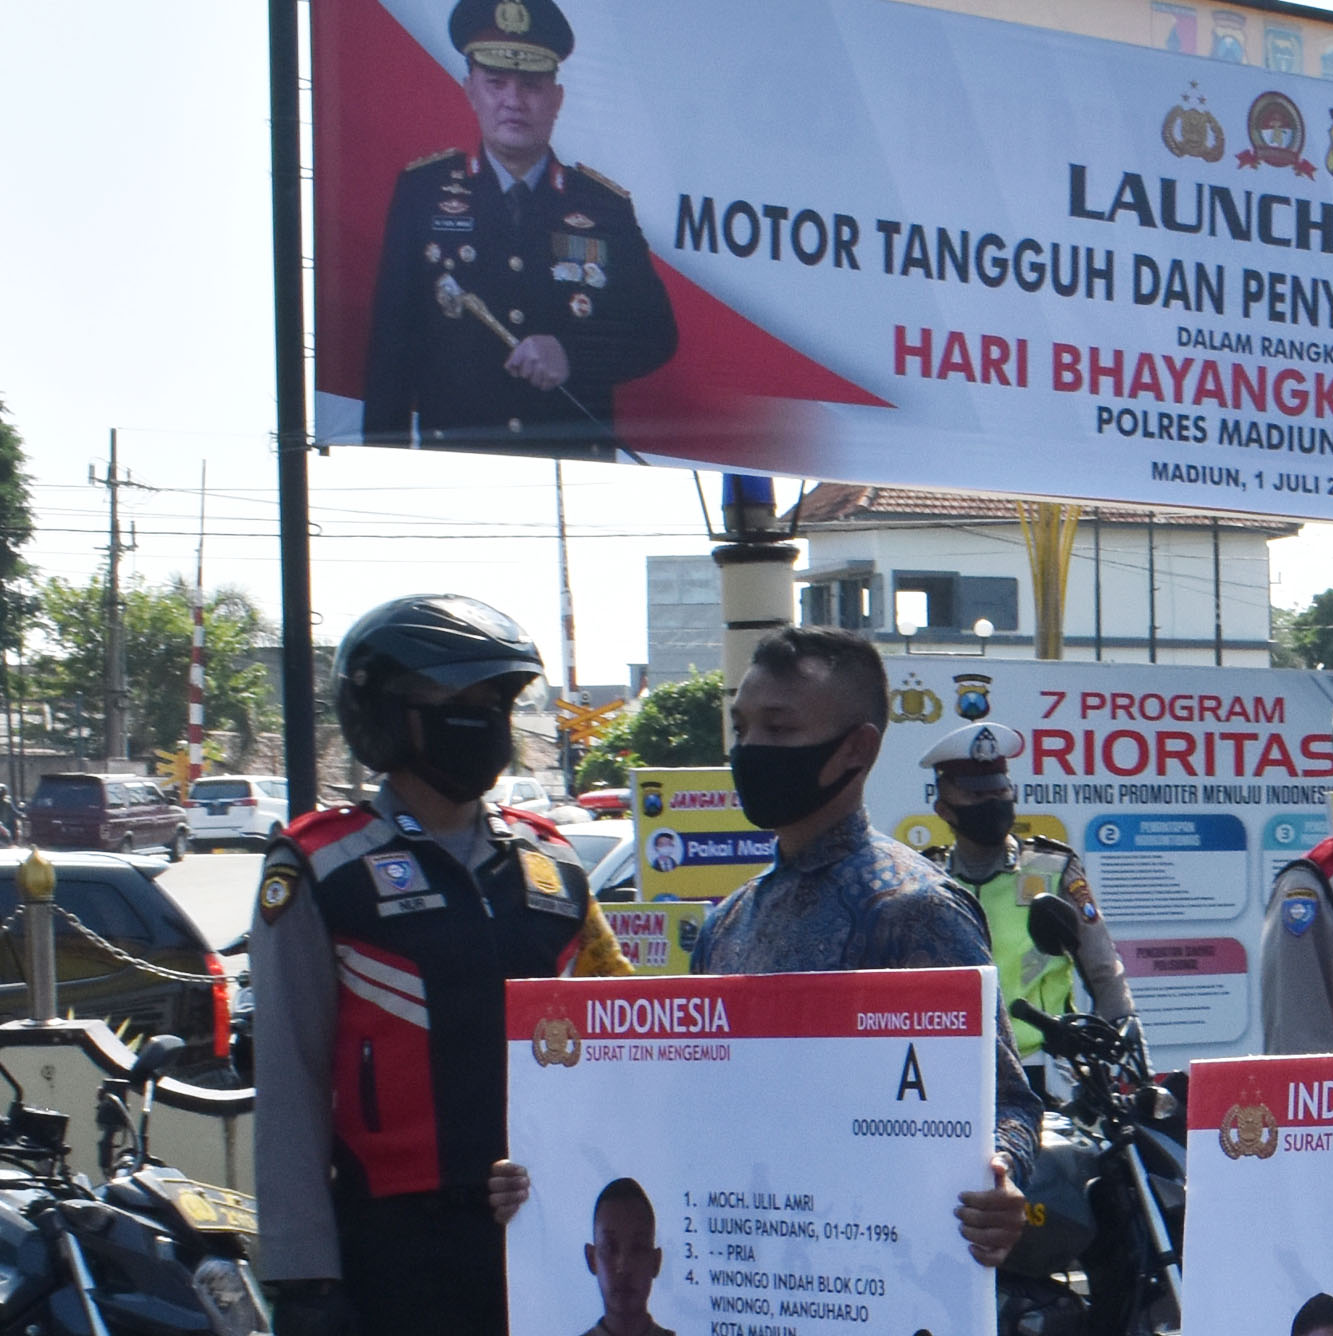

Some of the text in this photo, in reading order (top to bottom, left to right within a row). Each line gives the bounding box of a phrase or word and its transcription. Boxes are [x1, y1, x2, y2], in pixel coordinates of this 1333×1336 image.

[675, 194, 860, 270] MOTOR
[876, 219, 1114, 300] TANGGUH
[1133, 254, 1224, 315] DAN
[1178, 326, 1253, 355] DALAM
[893, 324, 1028, 388] HARI
[1096, 405, 1207, 444] POLRES
[1151, 460, 1246, 490] MADIUN,
[1255, 472, 1265, 489] 1
[1273, 473, 1320, 494] JULI
[1041, 691, 1285, 723] 7 PROGRAM
[670, 792, 726, 809] JANGAN
[1025, 784, 1068, 804] POLRI
[1071, 785, 1114, 804] YANG
[1120, 785, 1198, 804] PROMOTER
[1204, 785, 1263, 804] MENUJU
[916, 830, 922, 843] 1
[1105, 827, 1114, 841] 2
[1281, 829, 1290, 839] 3
[688, 841, 733, 857] Pakai
[605, 913, 665, 935] ANGAN
[586, 997, 729, 1033] INDONESIA
[857, 1012, 967, 1030] DRIVING LICENSE
[586, 1045, 730, 1061] SURAT IZIN MENGEMUDI
[896, 1042, 927, 1101] A
[852, 1119, 972, 1138] 00000000-000000
[1284, 1132, 1332, 1152] SURAT
[708, 1192, 814, 1212] MOCH. ULIL AMRI
[709, 1218, 898, 1242] UJUNG PANDANG, 01-07-1996
[728, 1244, 755, 1262] PRIA
[710, 1270, 885, 1297] WINONGO INDAH BLOK C/03
[711, 1296, 869, 1322] WINONGO, MANGUHARJO
